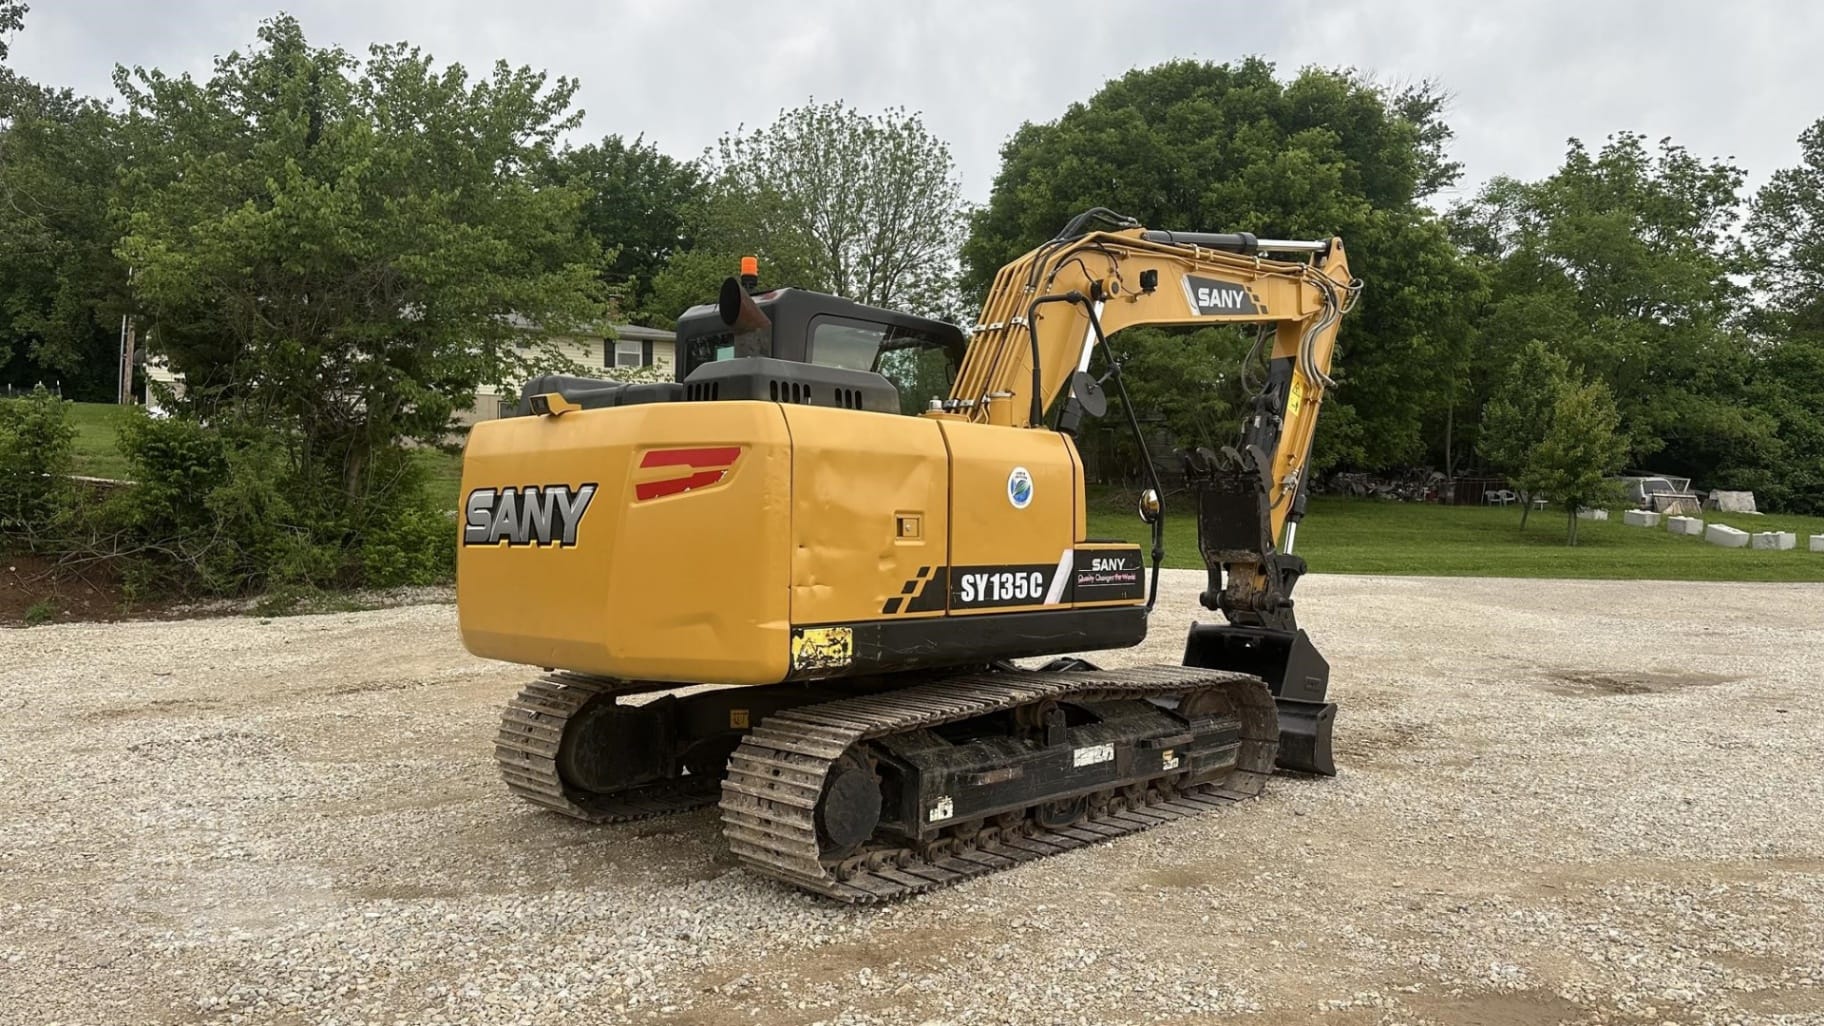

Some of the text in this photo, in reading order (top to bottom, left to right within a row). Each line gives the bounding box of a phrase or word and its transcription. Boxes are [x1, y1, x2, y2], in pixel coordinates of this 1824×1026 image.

[1198, 288, 1244, 309] SANY
[464, 483, 598, 547] SANY
[1092, 558, 1125, 571] SANY
[961, 572, 1043, 602] SY135C
